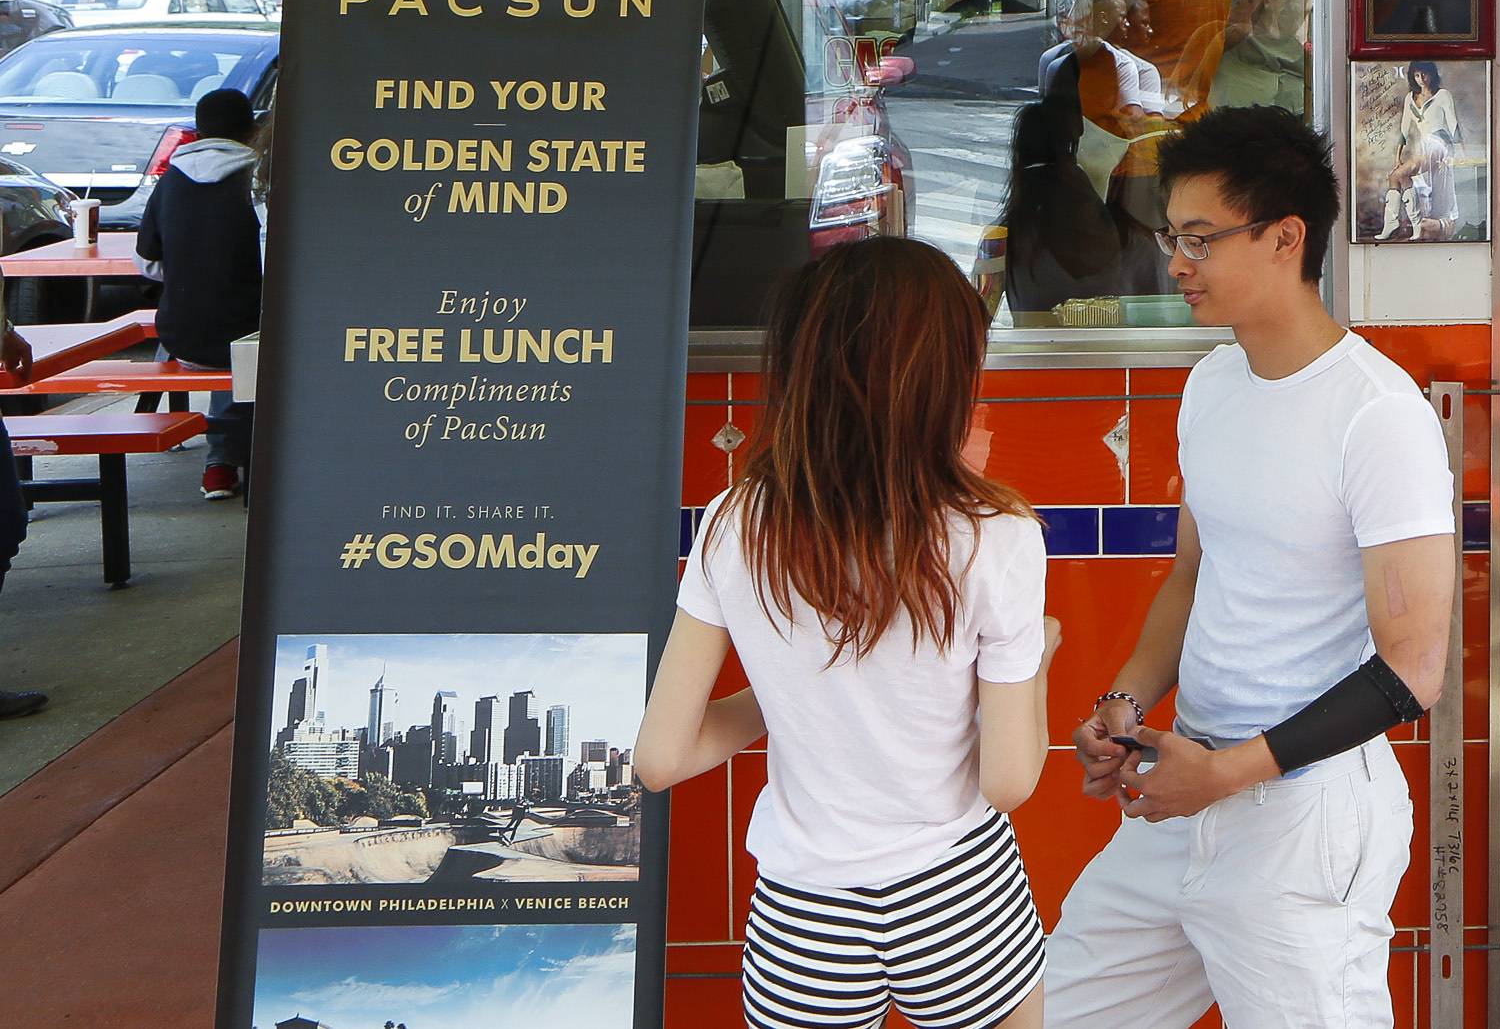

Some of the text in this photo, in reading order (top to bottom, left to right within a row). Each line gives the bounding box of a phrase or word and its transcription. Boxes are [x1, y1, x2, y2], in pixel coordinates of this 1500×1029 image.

[374, 79, 606, 111] FIND YOUR
[330, 138, 646, 173] GOLDEN STATE
[403, 181, 568, 223] of MIND
[435, 290, 527, 323] Enjoy
[343, 327, 614, 364] FREE LUNCH
[383, 375, 573, 409] Compliments
[403, 414, 546, 448] of PacSun
[381, 505, 555, 520] FIND IT. SHARE IT.
[339, 532, 601, 579] #GSOMday
[269, 899, 372, 914] DOWNTOWN
[379, 898, 495, 912] PHILADELPHIA
[514, 897, 572, 910] VENICE
[577, 897, 630, 910] BEACH
